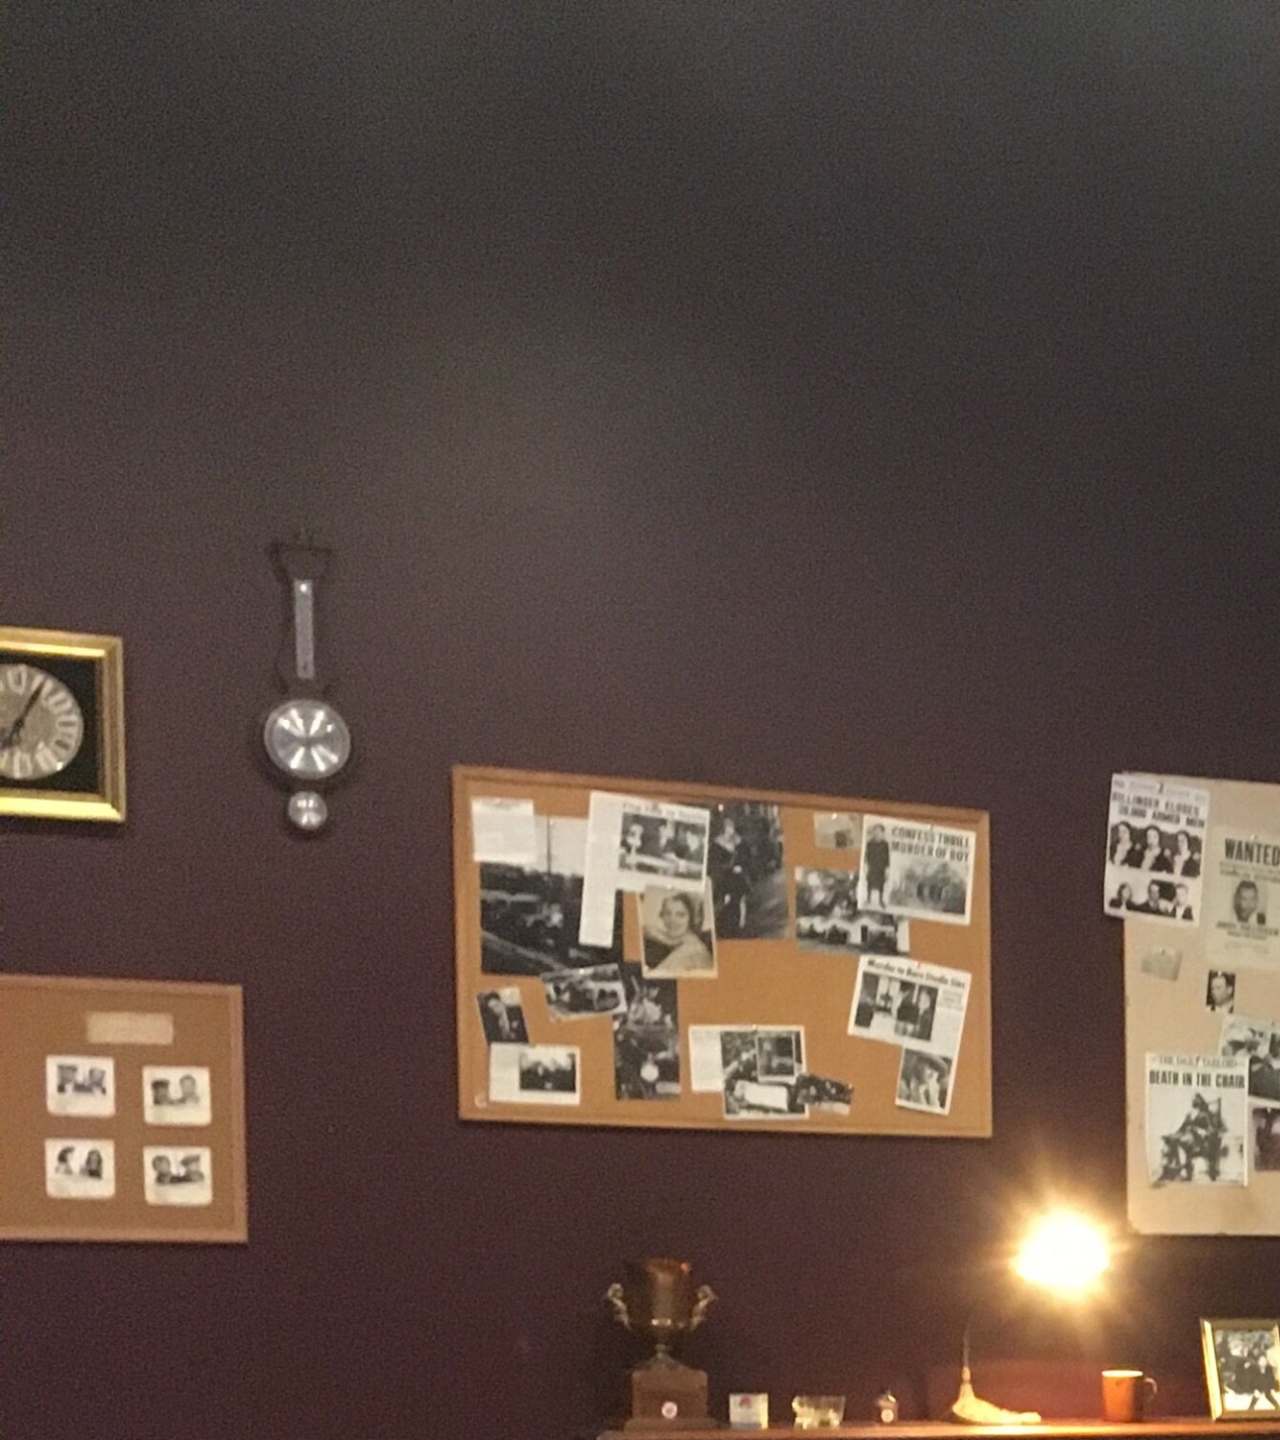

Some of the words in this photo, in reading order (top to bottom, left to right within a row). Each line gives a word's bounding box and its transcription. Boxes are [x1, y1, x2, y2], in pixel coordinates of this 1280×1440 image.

[1148, 1070, 1179, 1086] DEATH
[1182, 1072, 1193, 1087] IN
[1196, 1072, 1212, 1088] THE
[1215, 1073, 1246, 1090] CHAIR
